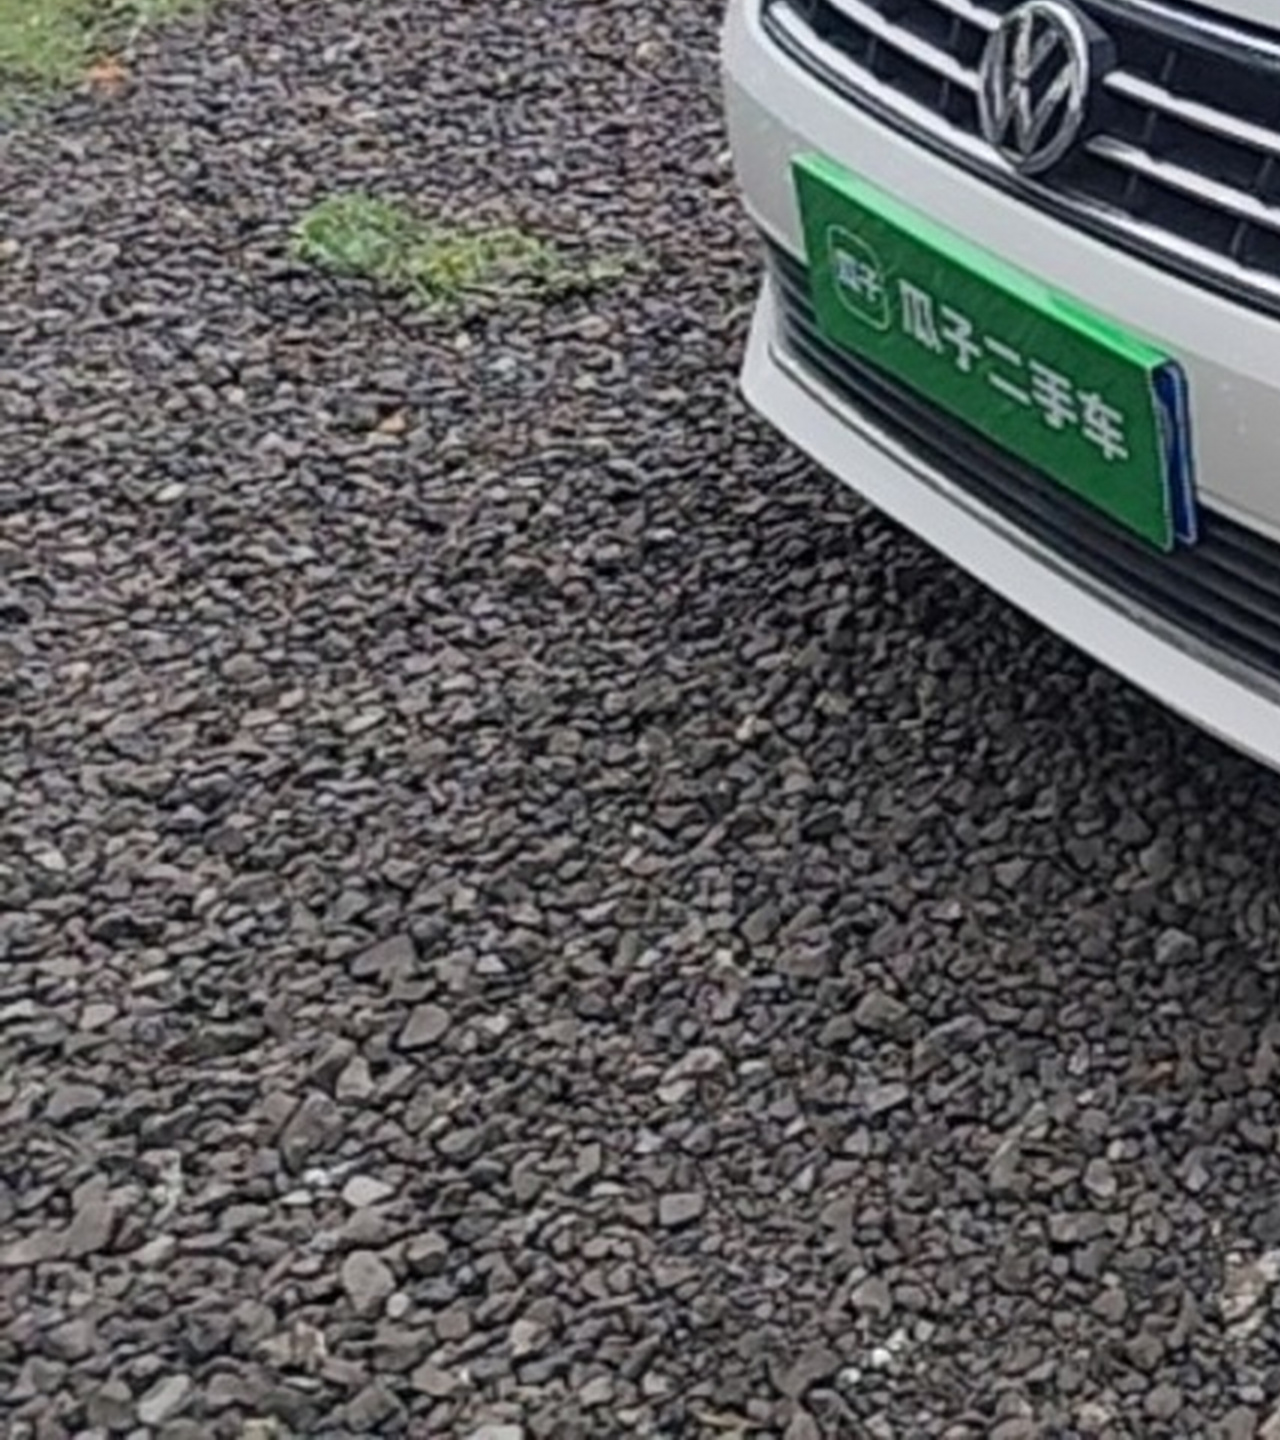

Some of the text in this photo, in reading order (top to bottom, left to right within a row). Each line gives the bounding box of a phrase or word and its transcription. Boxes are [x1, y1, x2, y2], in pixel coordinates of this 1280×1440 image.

[898, 278, 1129, 460] 瓜子二手车
